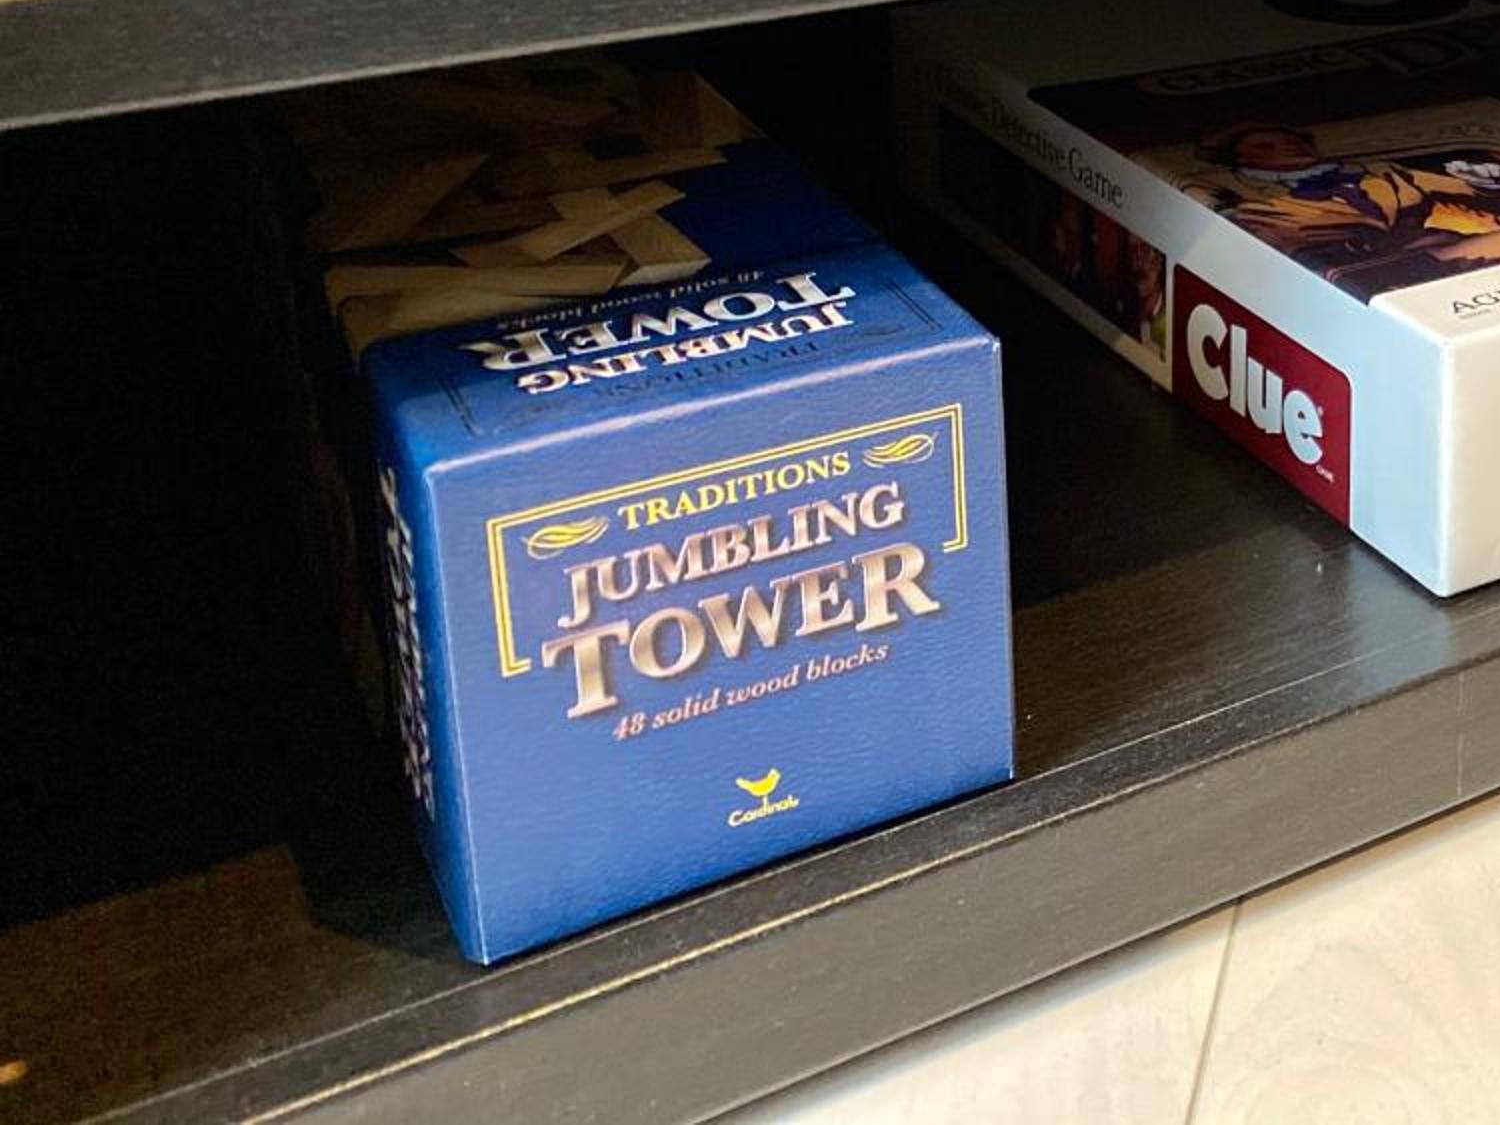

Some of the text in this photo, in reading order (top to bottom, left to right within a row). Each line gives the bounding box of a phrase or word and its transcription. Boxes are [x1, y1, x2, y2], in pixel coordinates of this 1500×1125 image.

[1067, 147, 1126, 209] Game
[456, 270, 857, 372] TOWER
[515, 300, 854, 396] JUMBLING
[1186, 303, 1325, 466] Clue
[617, 450, 852, 533] TRADITIONS
[557, 481, 906, 630] JUMBLING
[541, 540, 942, 719] TOWER
[611, 643, 890, 741] 48 solid wood blocks
